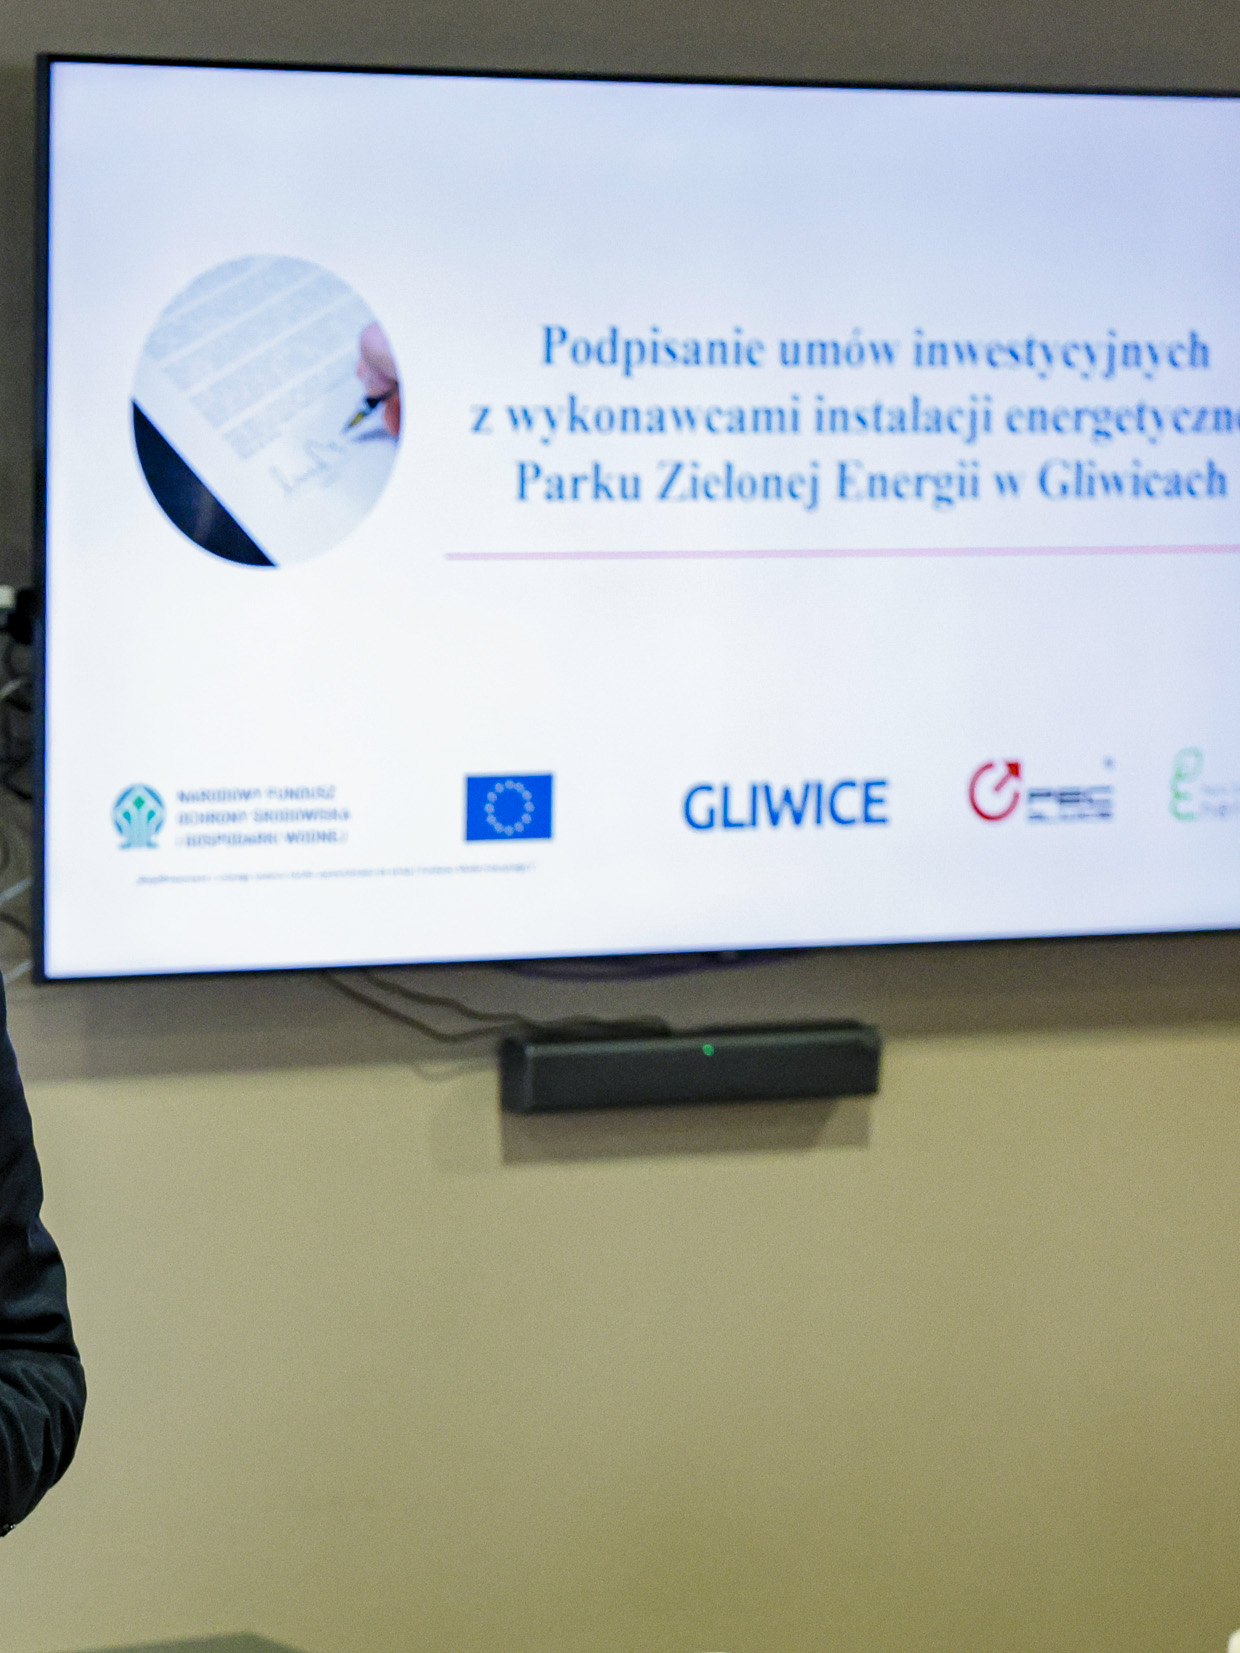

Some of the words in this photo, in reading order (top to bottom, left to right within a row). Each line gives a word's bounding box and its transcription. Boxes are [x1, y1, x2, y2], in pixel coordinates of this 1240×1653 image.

[541, 323, 765, 378] Podpisanie
[778, 326, 897, 369] umów
[912, 328, 1211, 381] inwestycyjnych
[470, 404, 494, 434] z
[506, 393, 802, 446] wykonawcami
[813, 393, 994, 446] instalacji
[1005, 400, 1240, 446] energetyczn
[515, 459, 642, 502] Parku
[657, 459, 821, 512] Zielonej
[836, 458, 981, 513] Energii
[993, 471, 1025, 500] w
[1037, 456, 1229, 501] Gliwicach
[682, 777, 890, 832] GLIWICE
